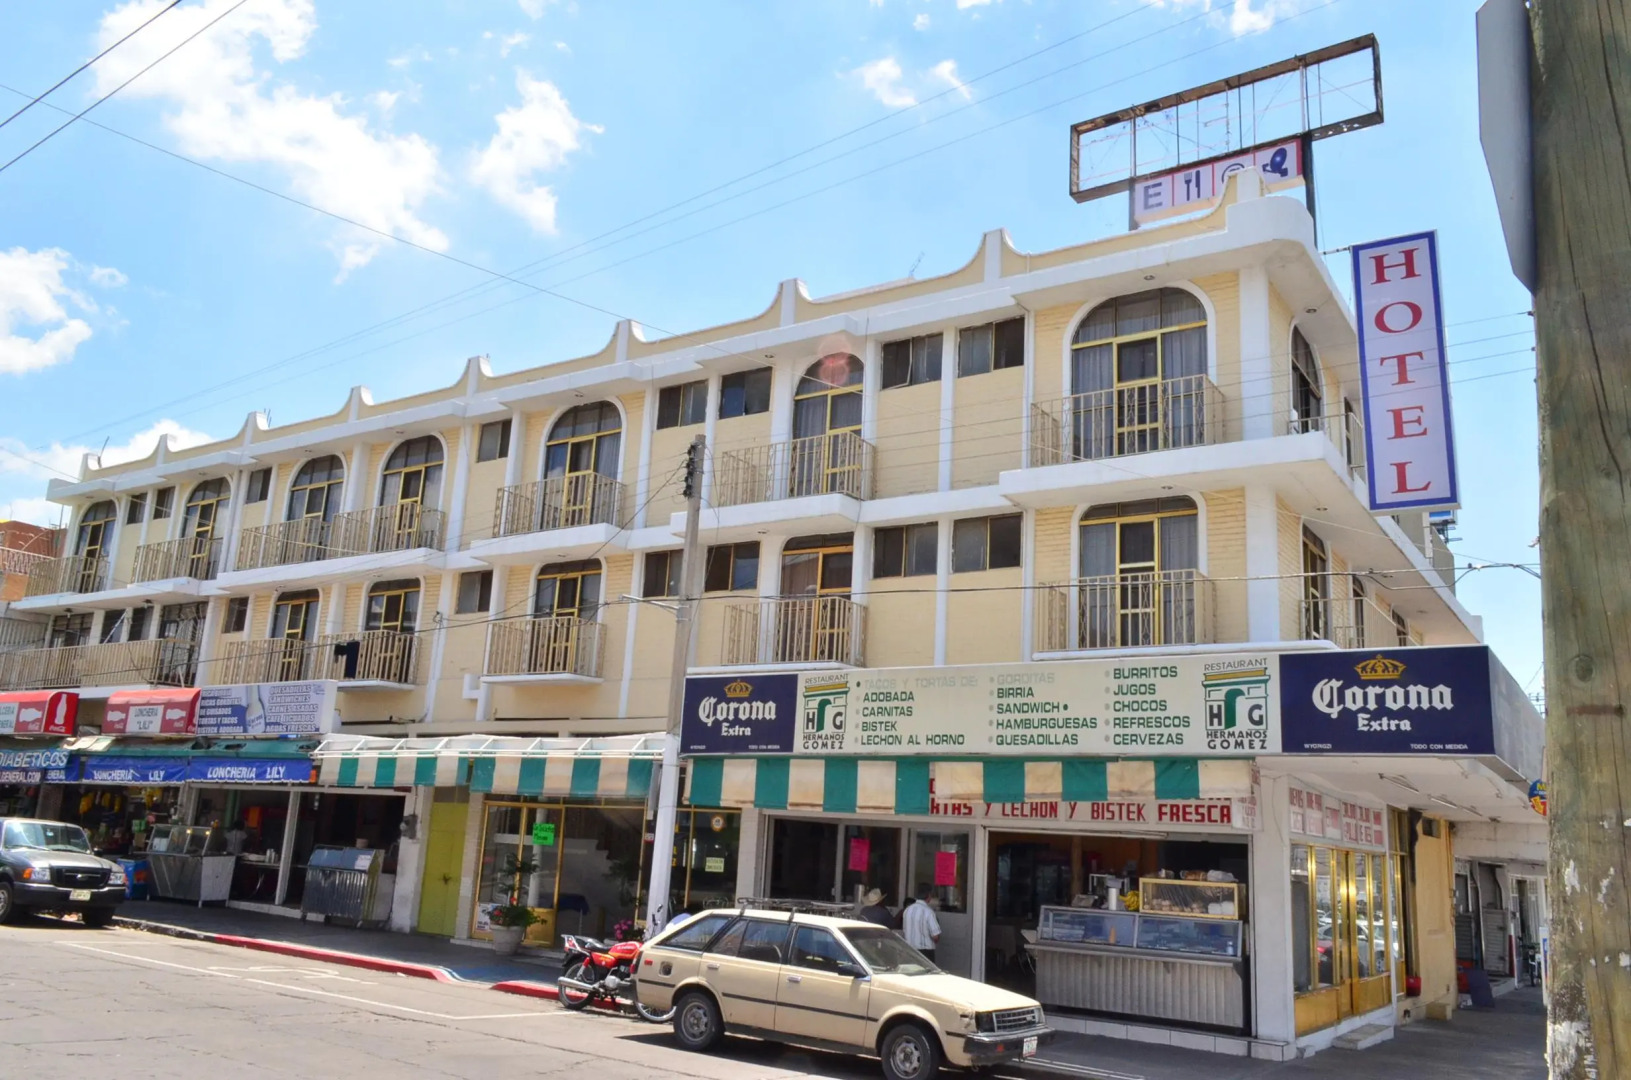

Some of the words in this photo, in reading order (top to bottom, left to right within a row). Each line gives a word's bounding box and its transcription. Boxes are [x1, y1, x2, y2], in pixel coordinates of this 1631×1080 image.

[1369, 247, 1431, 494] HOTEL
[1204, 658, 1268, 672] RESTAURANT
[997, 672, 1055, 685] GORDITAS
[1113, 666, 1178, 679] BURRITOS
[805, 674, 849, 685] RESTAURANT
[864, 678, 896, 690] TACOS
[914, 675, 956, 688] TORTAS
[997, 687, 1034, 698] BIRRIA
[1113, 683, 1156, 695] JUGOS
[863, 691, 915, 703] ADOBADA
[1311, 678, 1454, 719] Corona
[699, 696, 777, 727] Corona
[862, 706, 913, 718] CARNITAS
[996, 702, 1060, 714] SANDWICH
[1113, 700, 1168, 712] CHOCOS
[861, 720, 898, 732] BISTEK
[996, 717, 1098, 730] HAMBURGUESAS
[1113, 716, 1191, 729] REFRESCOS
[1357, 713, 1412, 732] Extra
[721, 722, 752, 737] Extra
[1206, 729, 1268, 740] HERMANOS
[803, 733, 845, 742] HERMANOS
[861, 734, 903, 746] LECHON
[907, 734, 921, 745] AL
[925, 734, 965, 746] HORNO
[996, 733, 1079, 746] QUESADILLAS
[1113, 732, 1184, 746] CERVEZAS
[803, 739, 844, 750] GOMEZ
[1207, 739, 1268, 750] GOMEZ
[149, 769, 165, 781] LILY
[206, 766, 257, 779] LONCHERIA
[266, 765, 286, 779] LILY
[1001, 801, 1058, 818] LECHON
[1068, 801, 1078, 819] Y
[1090, 801, 1147, 822] BISTEK
[1157, 803, 1232, 824] FRESCA
